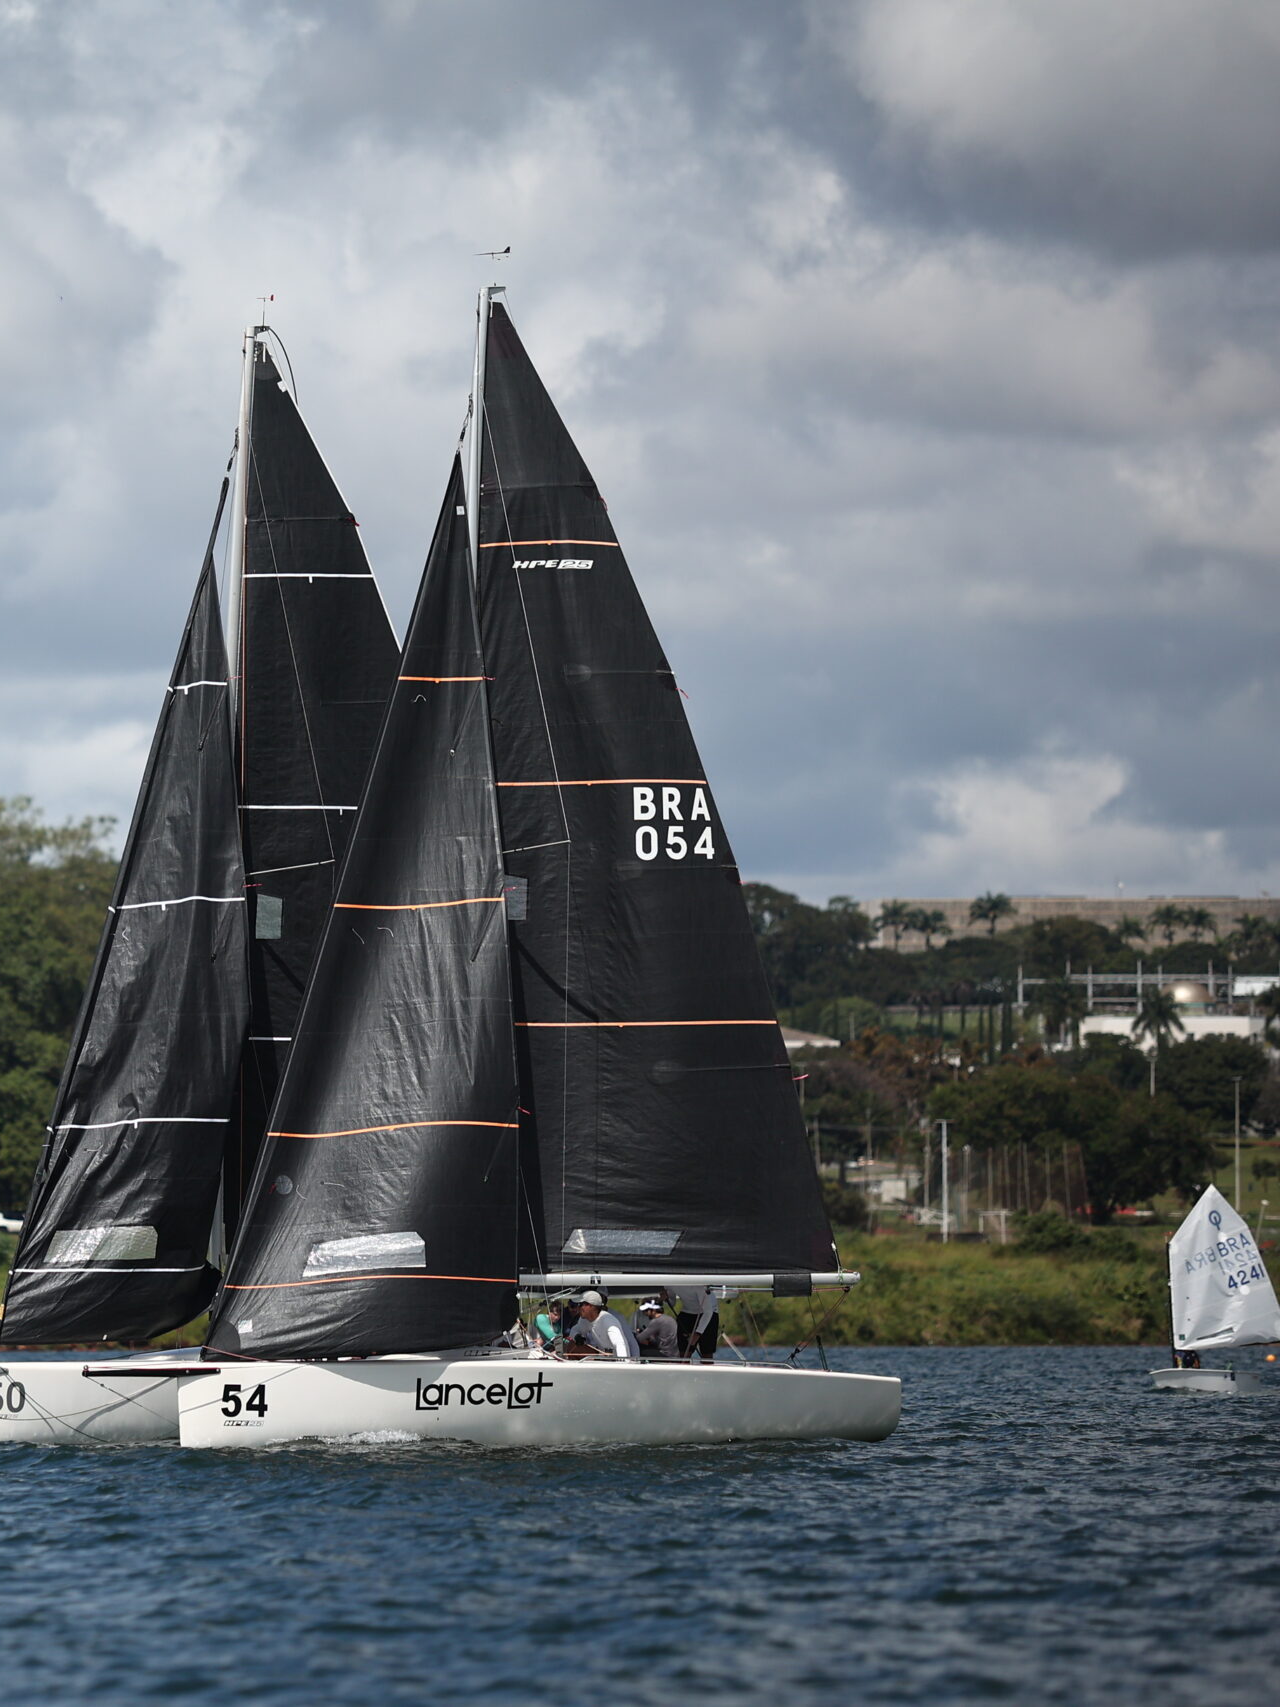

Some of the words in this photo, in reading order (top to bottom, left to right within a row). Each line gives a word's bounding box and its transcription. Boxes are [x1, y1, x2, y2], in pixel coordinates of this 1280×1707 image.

[633, 786, 711, 821] BRA
[635, 825, 715, 861] 054
[1216, 1232, 1251, 1258] BRA
[1227, 1263, 1265, 1290] 4241
[221, 1384, 268, 1418] 54
